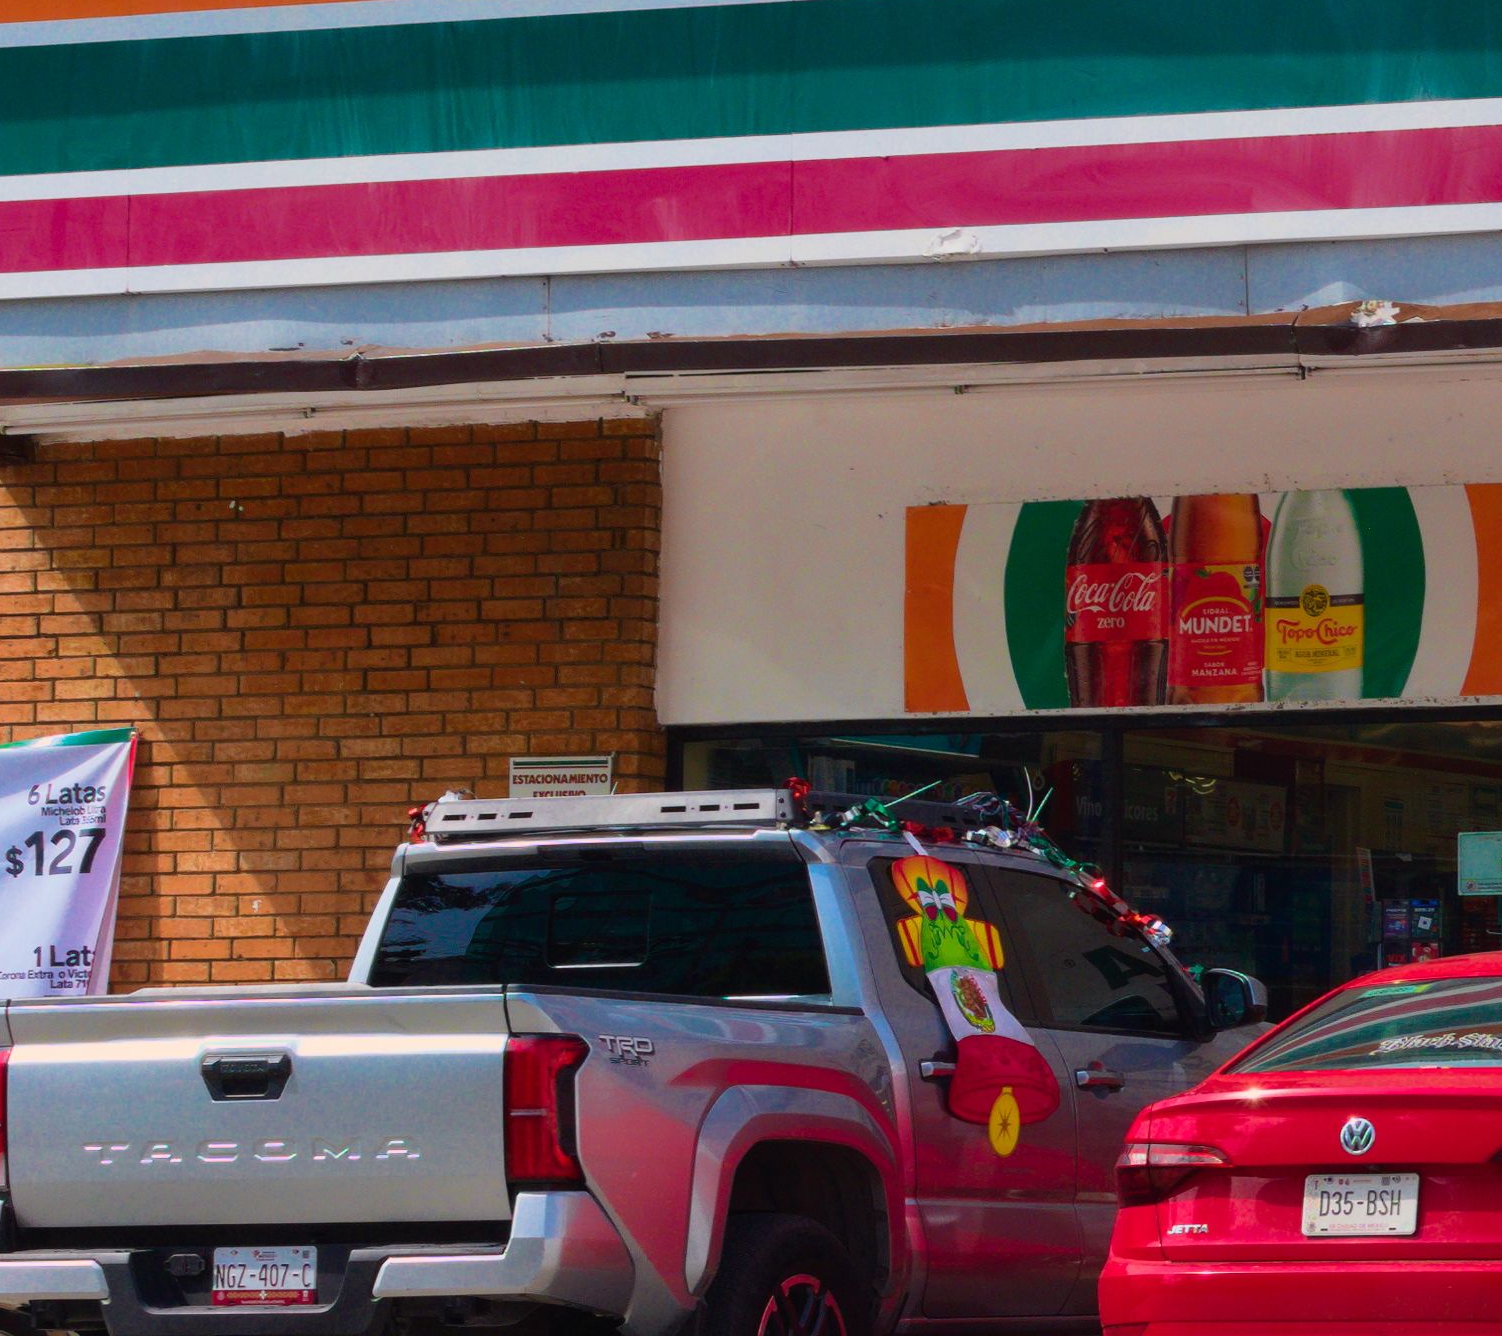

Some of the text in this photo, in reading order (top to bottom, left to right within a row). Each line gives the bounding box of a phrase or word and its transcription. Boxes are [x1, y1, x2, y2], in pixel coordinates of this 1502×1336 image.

[1097, 615, 1126, 629] zero
[1179, 614, 1253, 636] MUNDET
[1276, 617, 1358, 645] Topo Chico
[1191, 667, 1238, 677] MANZANA
[512, 773, 608, 785] ESTACIONAMIENTO
[26, 782, 106, 806] 6 Latas
[41, 806, 85, 816] Michelob
[59, 815, 80, 825] Lata
[4, 827, 107, 878] $127
[33, 946, 42, 968] 1
[27, 970, 54, 980] Extra
[59, 971, 65, 979] o
[50, 979, 73, 989] Lata
[598, 1034, 655, 1057] TRD
[83, 1137, 421, 1164] TACOMA
[1318, 1189, 1401, 1216] D35-BSH
[1166, 1223, 1209, 1235] JETTA
[214, 1263, 313, 1290] NGZ-407-C
